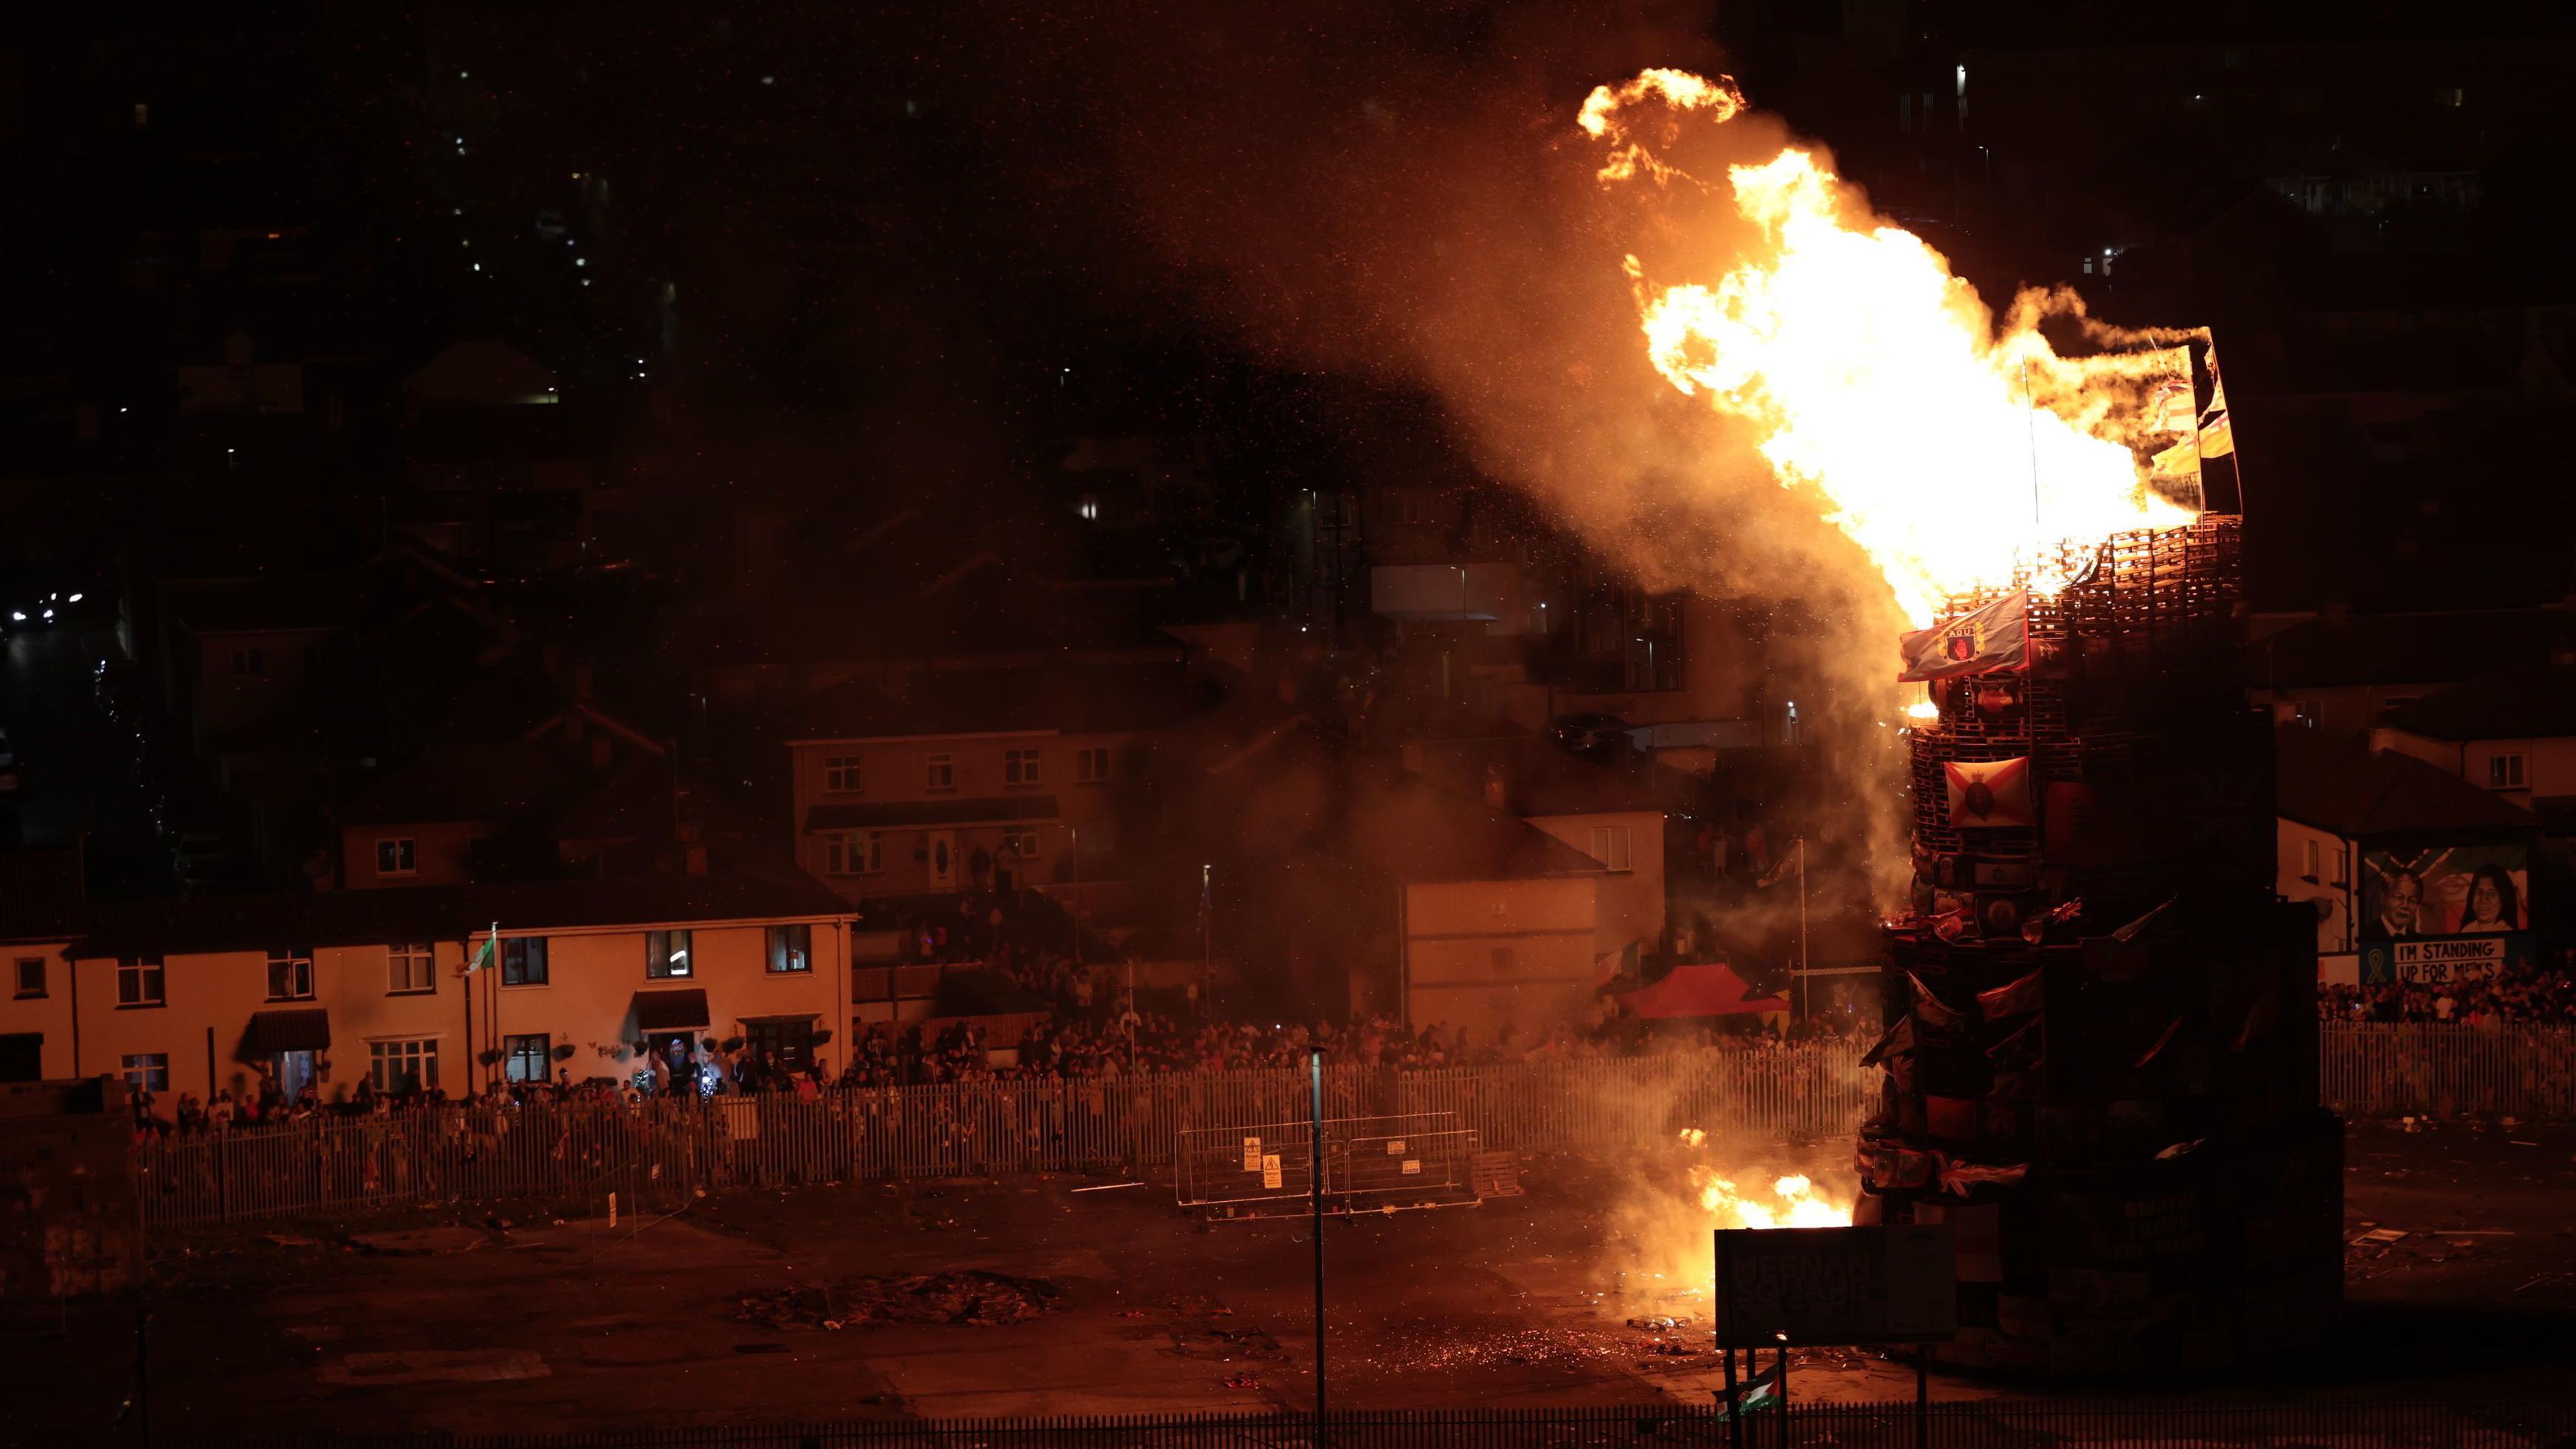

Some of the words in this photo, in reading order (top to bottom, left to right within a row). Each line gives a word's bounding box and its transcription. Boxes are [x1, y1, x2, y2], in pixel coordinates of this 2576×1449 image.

[2400, 945, 2417, 961] I'M
[2423, 942, 2495, 959] STANDING
[2401, 965, 2418, 981] UP
[2423, 964, 2448, 981] FOR
